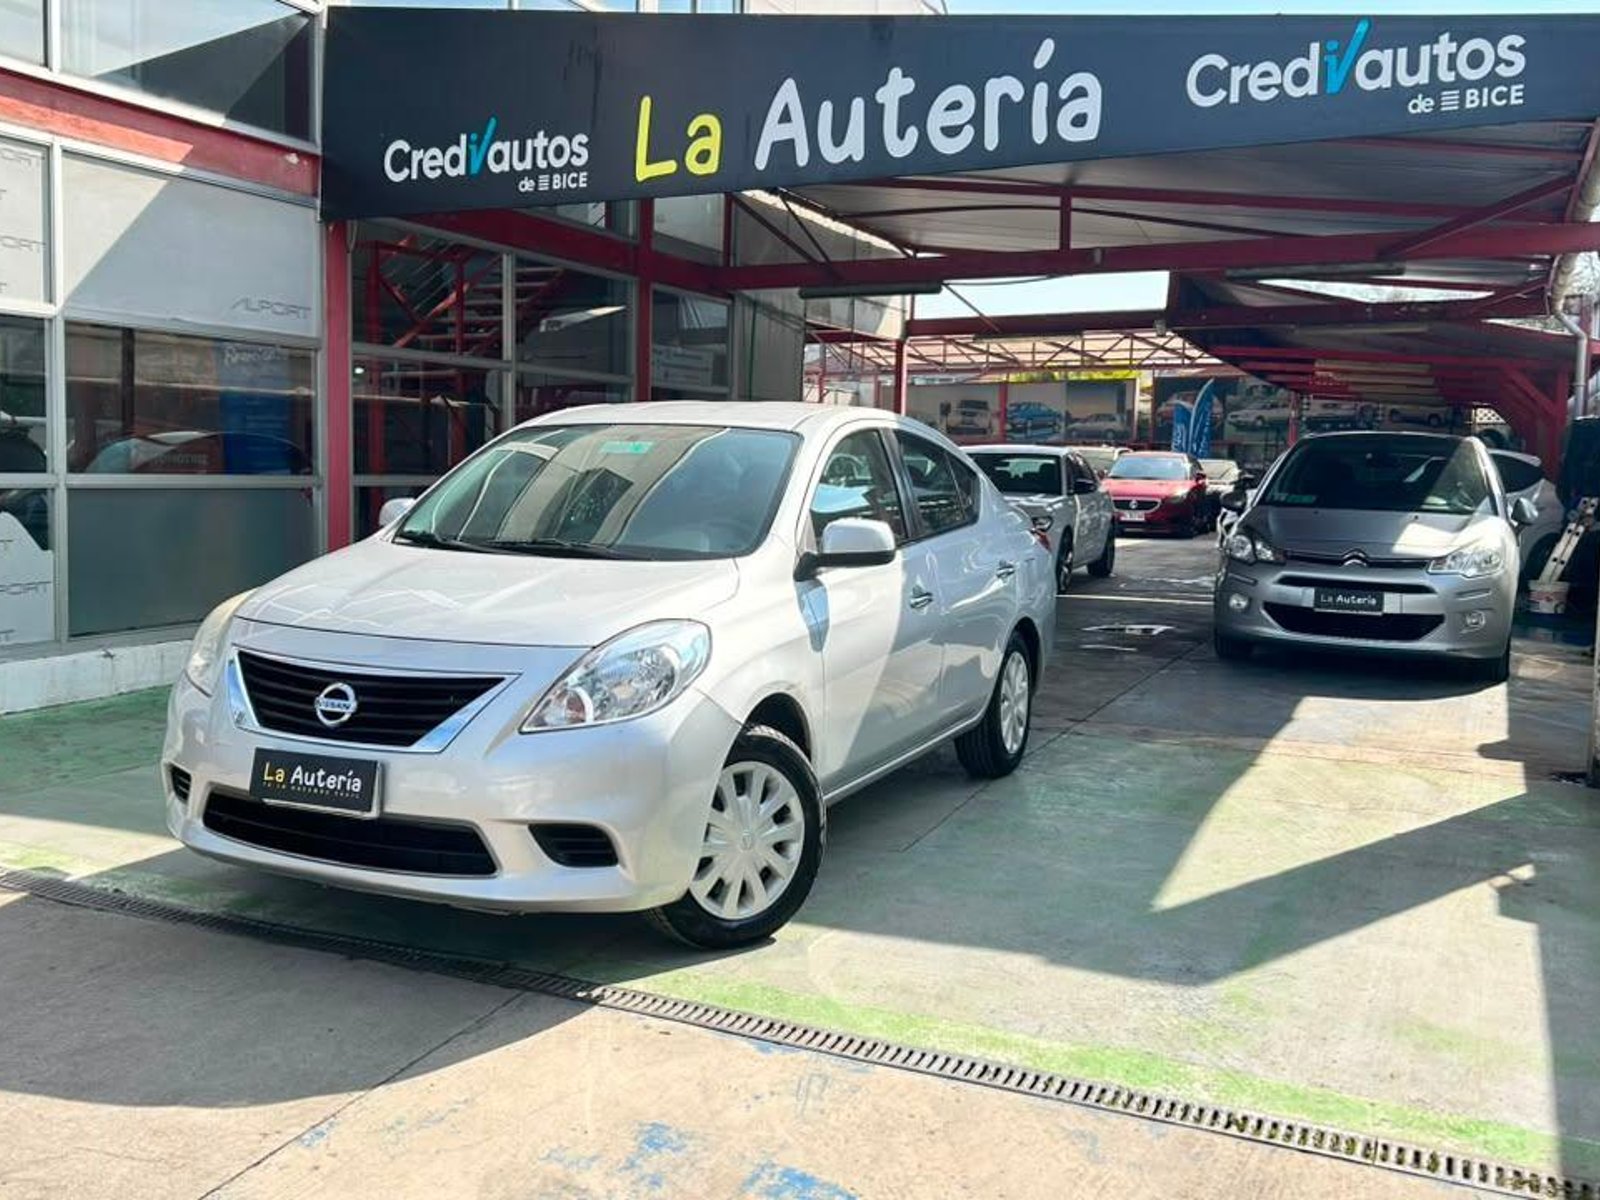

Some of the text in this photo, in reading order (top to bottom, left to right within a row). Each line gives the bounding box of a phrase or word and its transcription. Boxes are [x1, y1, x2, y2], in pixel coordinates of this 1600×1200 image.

[635, 38, 1103, 182] La Autería
[1407, 83, 1526, 115] de BICE
[518, 172, 588, 193] de BICE
[264, 762, 285, 782] La
[290, 765, 361, 792] Autería
